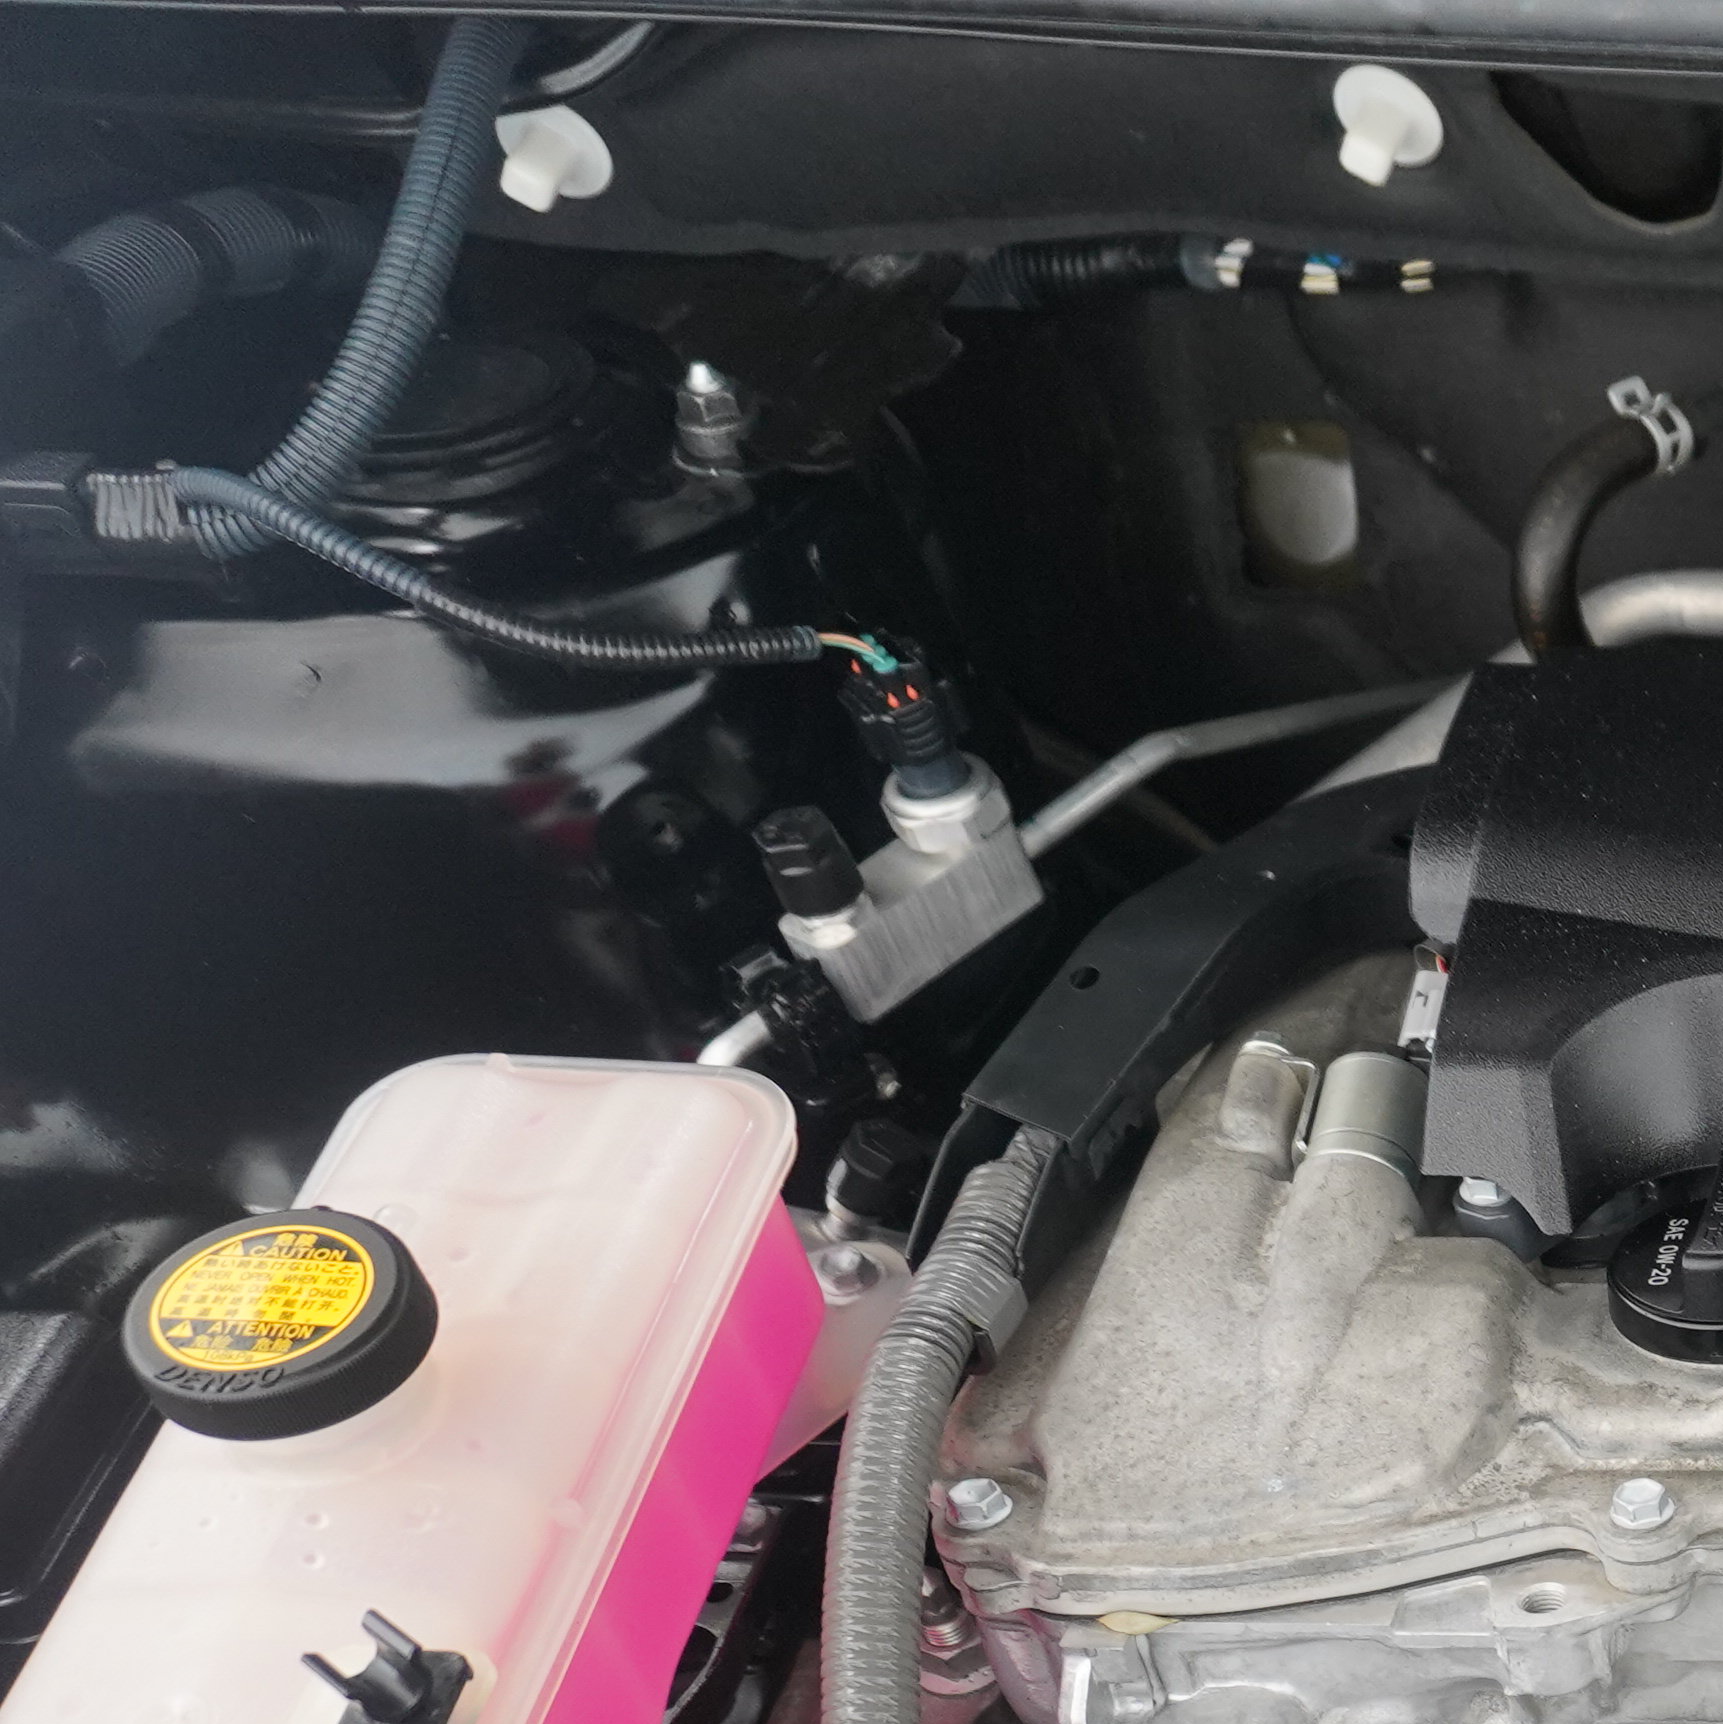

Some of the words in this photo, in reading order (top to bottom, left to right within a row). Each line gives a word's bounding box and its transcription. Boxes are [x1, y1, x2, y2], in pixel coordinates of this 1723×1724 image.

[1663, 1218, 1690, 1242] SAE
[249, 1245, 348, 1262] CAUTION
[1648, 1244, 1679, 1287] 0W-20
[191, 1270, 233, 1281] NEVER
[239, 1271, 274, 1282] OPEN
[283, 1275, 321, 1286] WHEN
[207, 1322, 316, 1339] ATTENTION
[154, 1365, 286, 1394] DENSO
